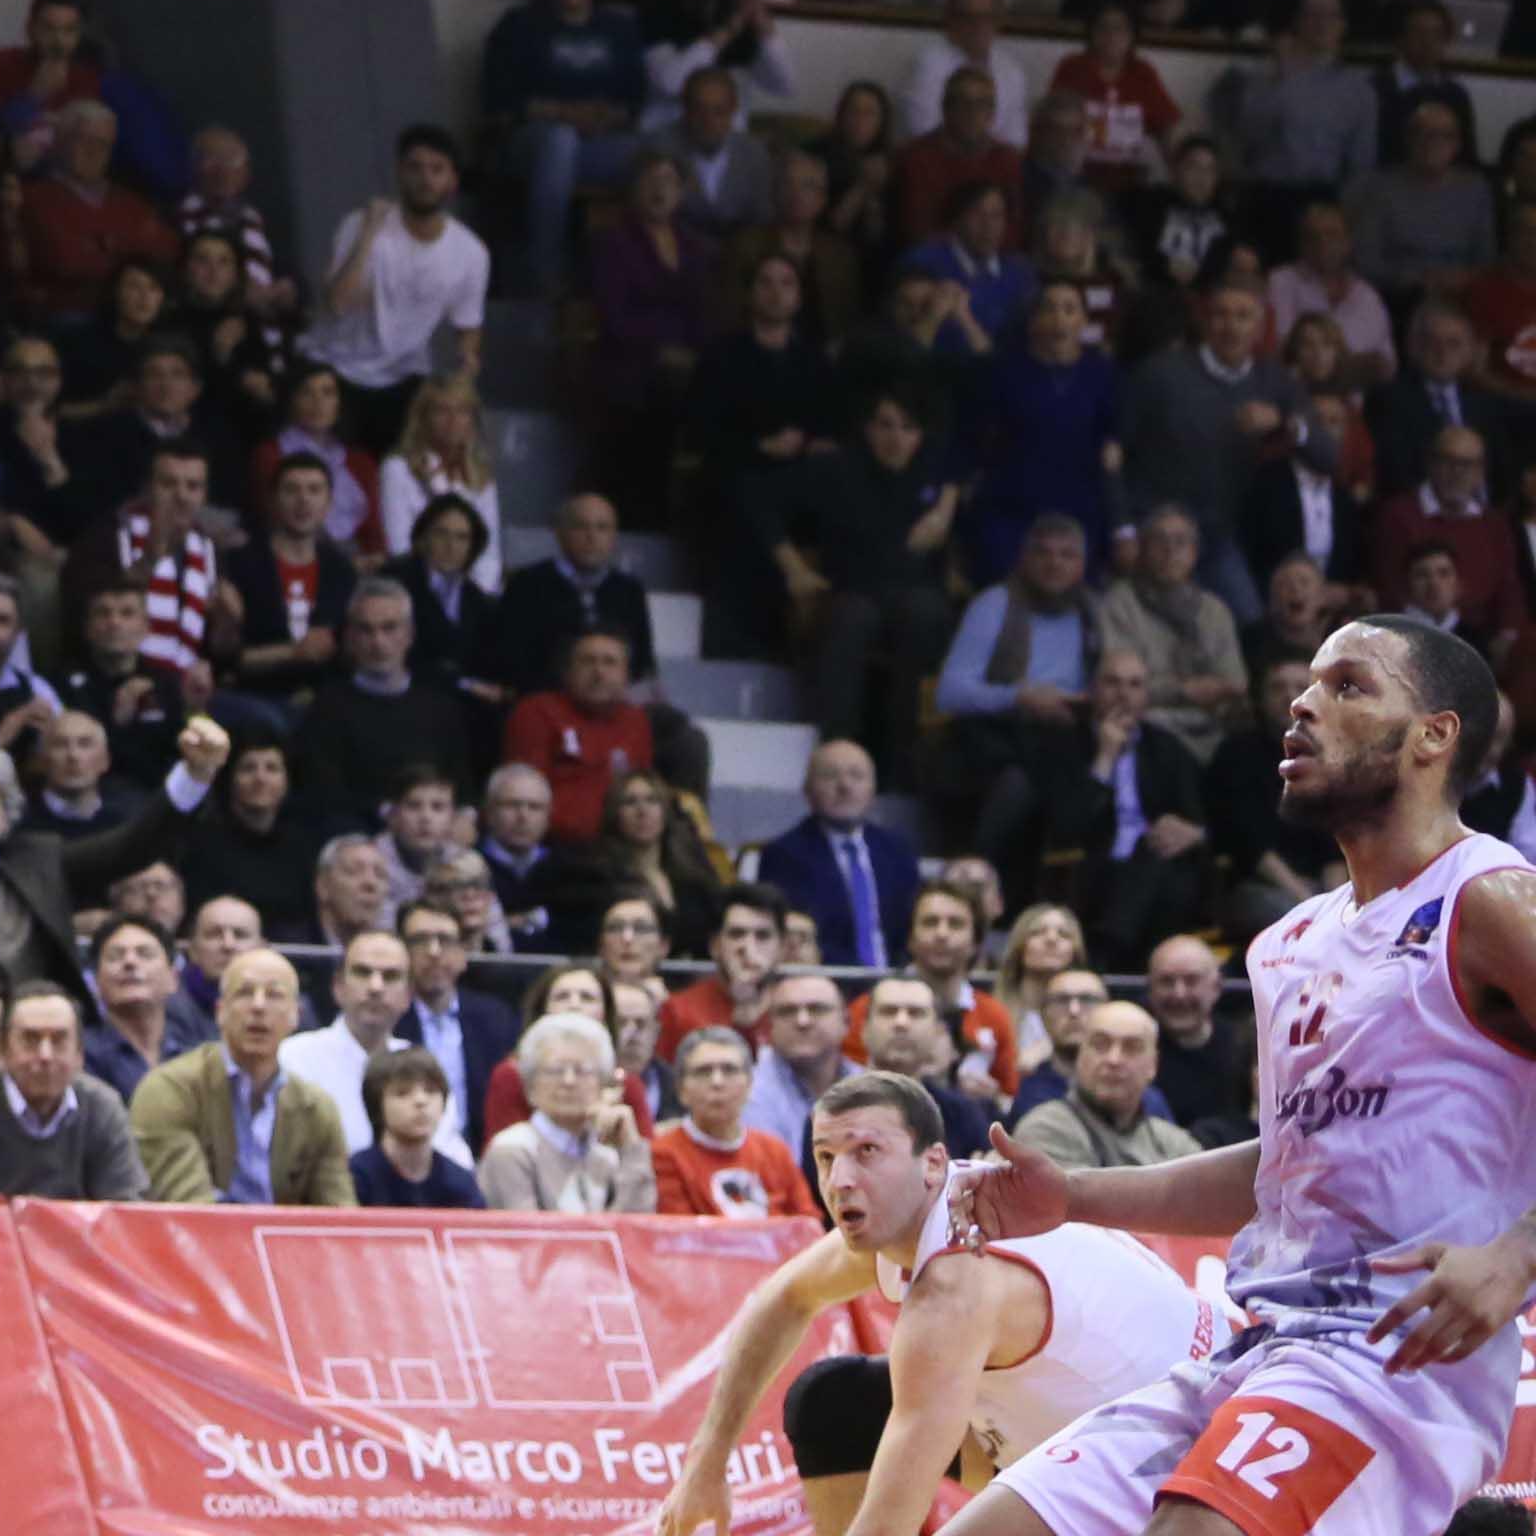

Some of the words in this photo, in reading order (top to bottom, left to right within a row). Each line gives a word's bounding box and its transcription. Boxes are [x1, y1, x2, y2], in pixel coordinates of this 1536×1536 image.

[196, 1423, 388, 1482] Studio
[403, 1427, 584, 1484] Marco
[593, 1428, 785, 1485] Ferari
[1215, 1411, 1311, 1501] 12
[368, 1490, 511, 1520] ambientali
[518, 1496, 536, 1519] e
